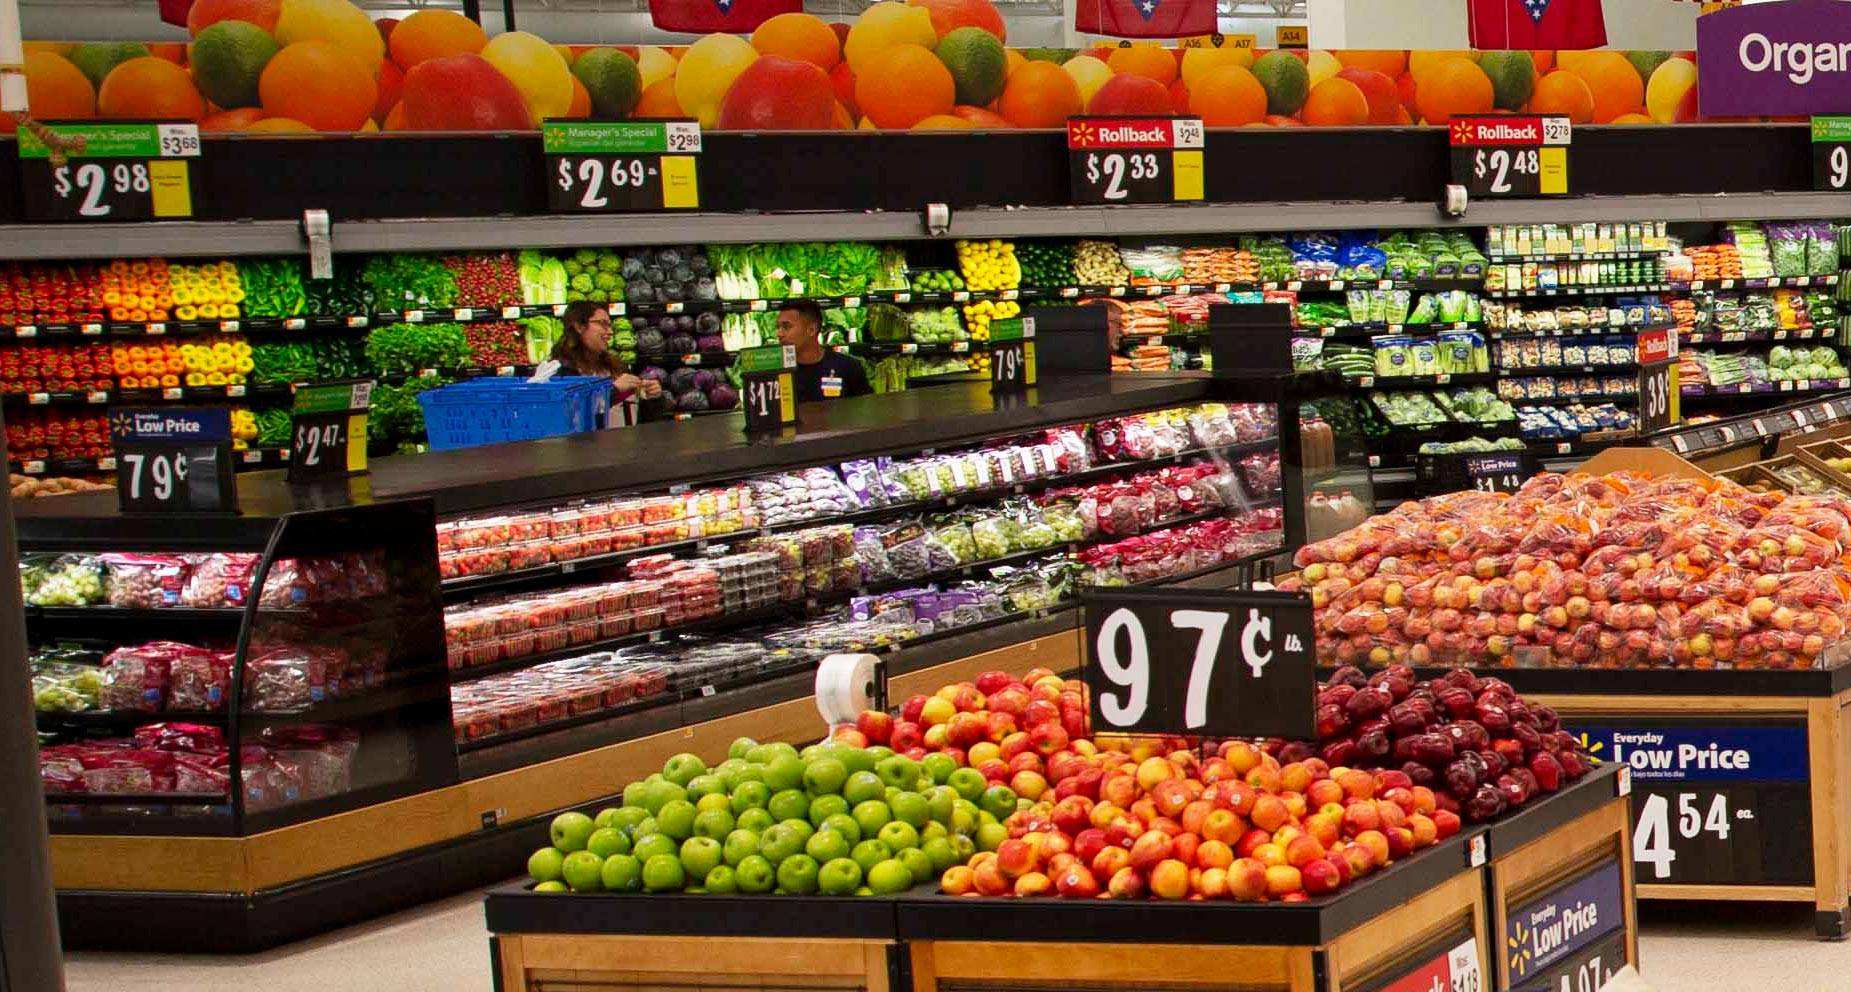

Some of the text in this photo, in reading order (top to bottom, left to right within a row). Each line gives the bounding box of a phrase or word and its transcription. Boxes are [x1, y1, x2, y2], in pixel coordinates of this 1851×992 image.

[1099, 127, 1166, 143] Rollback
[1478, 125, 1537, 140] Rollback
[135, 419, 200, 434] Low Price
[1097, 608, 1303, 728] 97¢ lb.
[1613, 732, 1663, 745] Everyday
[1613, 742, 1750, 769] Low Price
[1736, 808, 1754, 819] ea.
[1532, 920, 1562, 958] Low
[1563, 900, 1598, 941] Price
